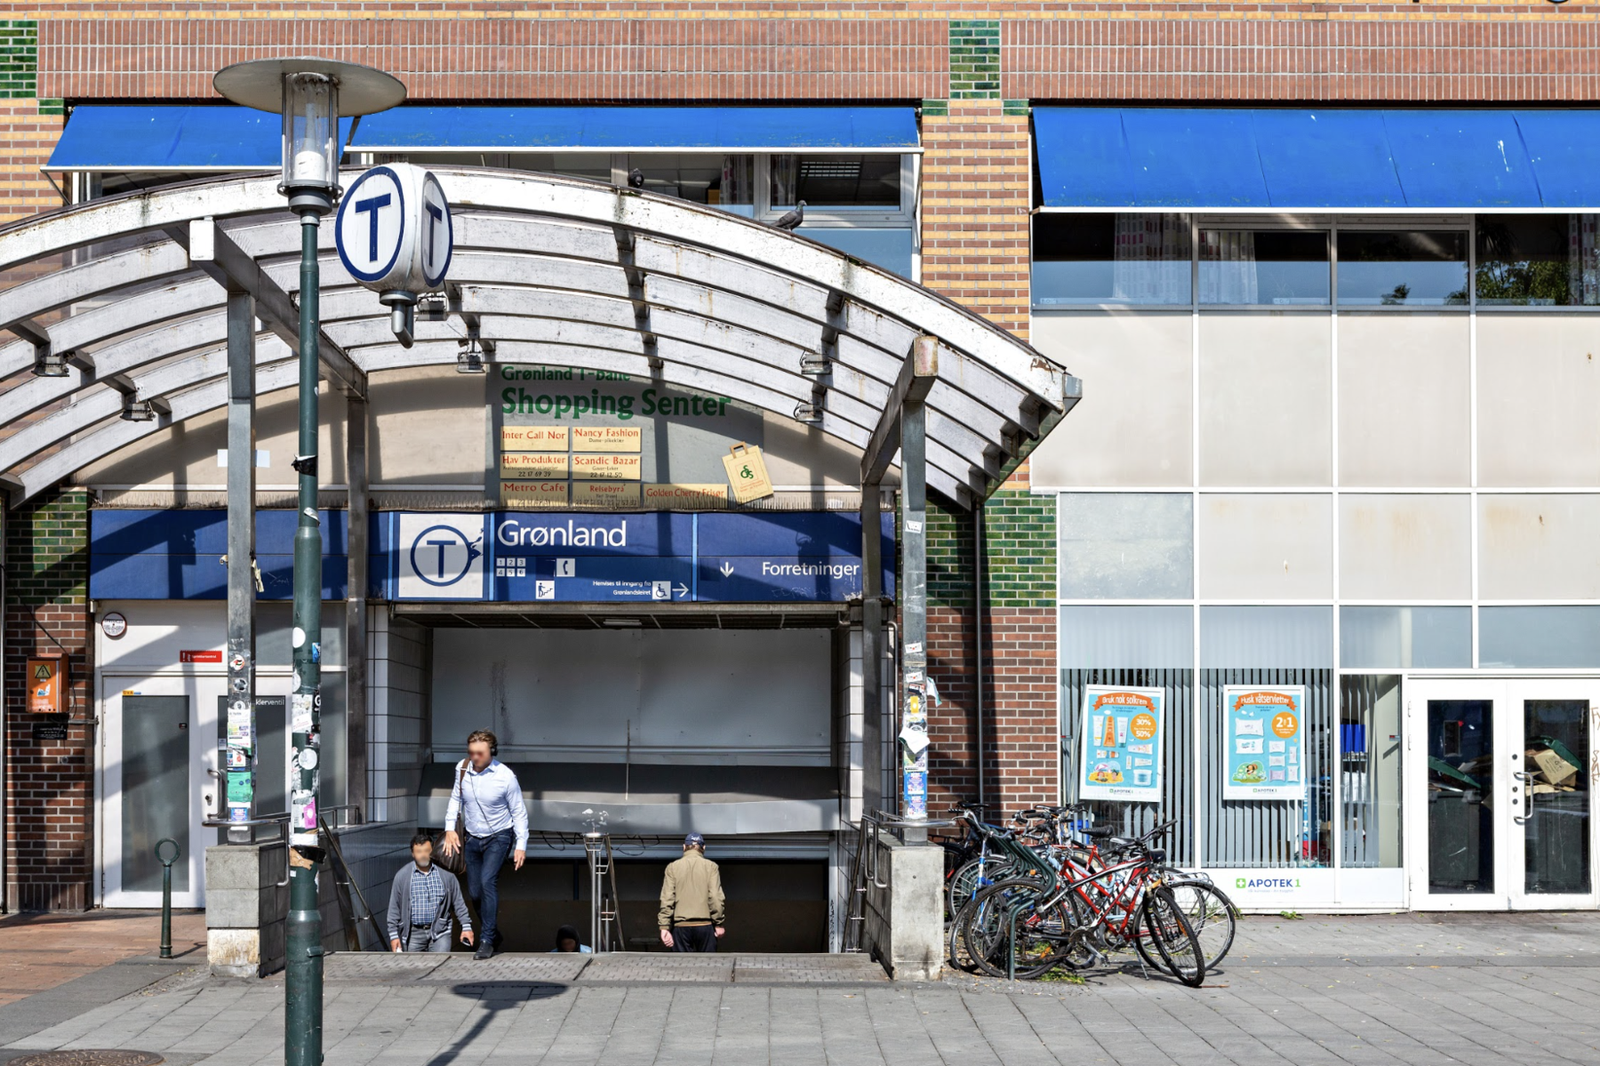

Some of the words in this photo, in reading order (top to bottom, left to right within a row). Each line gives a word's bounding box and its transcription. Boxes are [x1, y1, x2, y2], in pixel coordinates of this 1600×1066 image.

[355, 193, 392, 262] T
[425, 196, 442, 268] T
[502, 366, 572, 381] Grønland
[502, 387, 635, 420] Shopping
[642, 388, 731, 417] Senter
[502, 430, 523, 439] Inter
[526, 430, 544, 439] Call
[548, 431, 566, 439] Nor
[575, 428, 603, 438] Nancy
[606, 428, 639, 437] Fashion
[502, 456, 518, 464] Hav
[522, 456, 566, 464] Produkter
[575, 456, 610, 465] Scandic
[613, 456, 638, 465] Bazar
[504, 483, 537, 492] Metro
[540, 483, 565, 492] Cafe
[646, 488, 673, 497] Golden
[674, 488, 700, 498] Cherry
[702, 488, 724, 497] Frisør
[498, 520, 627, 547] Grønland
[426, 540, 456, 578] T
[762, 561, 859, 579] Forretninger
[1116, 694, 1125, 703] nok
[1126, 695, 1148, 704] solkrem
[1241, 695, 1254, 703] Husk
[1276, 717, 1283, 727] 2
[1287, 717, 1294, 727] 1
[1248, 879, 1293, 887] APOTEK
[1295, 879, 1301, 887] 1
